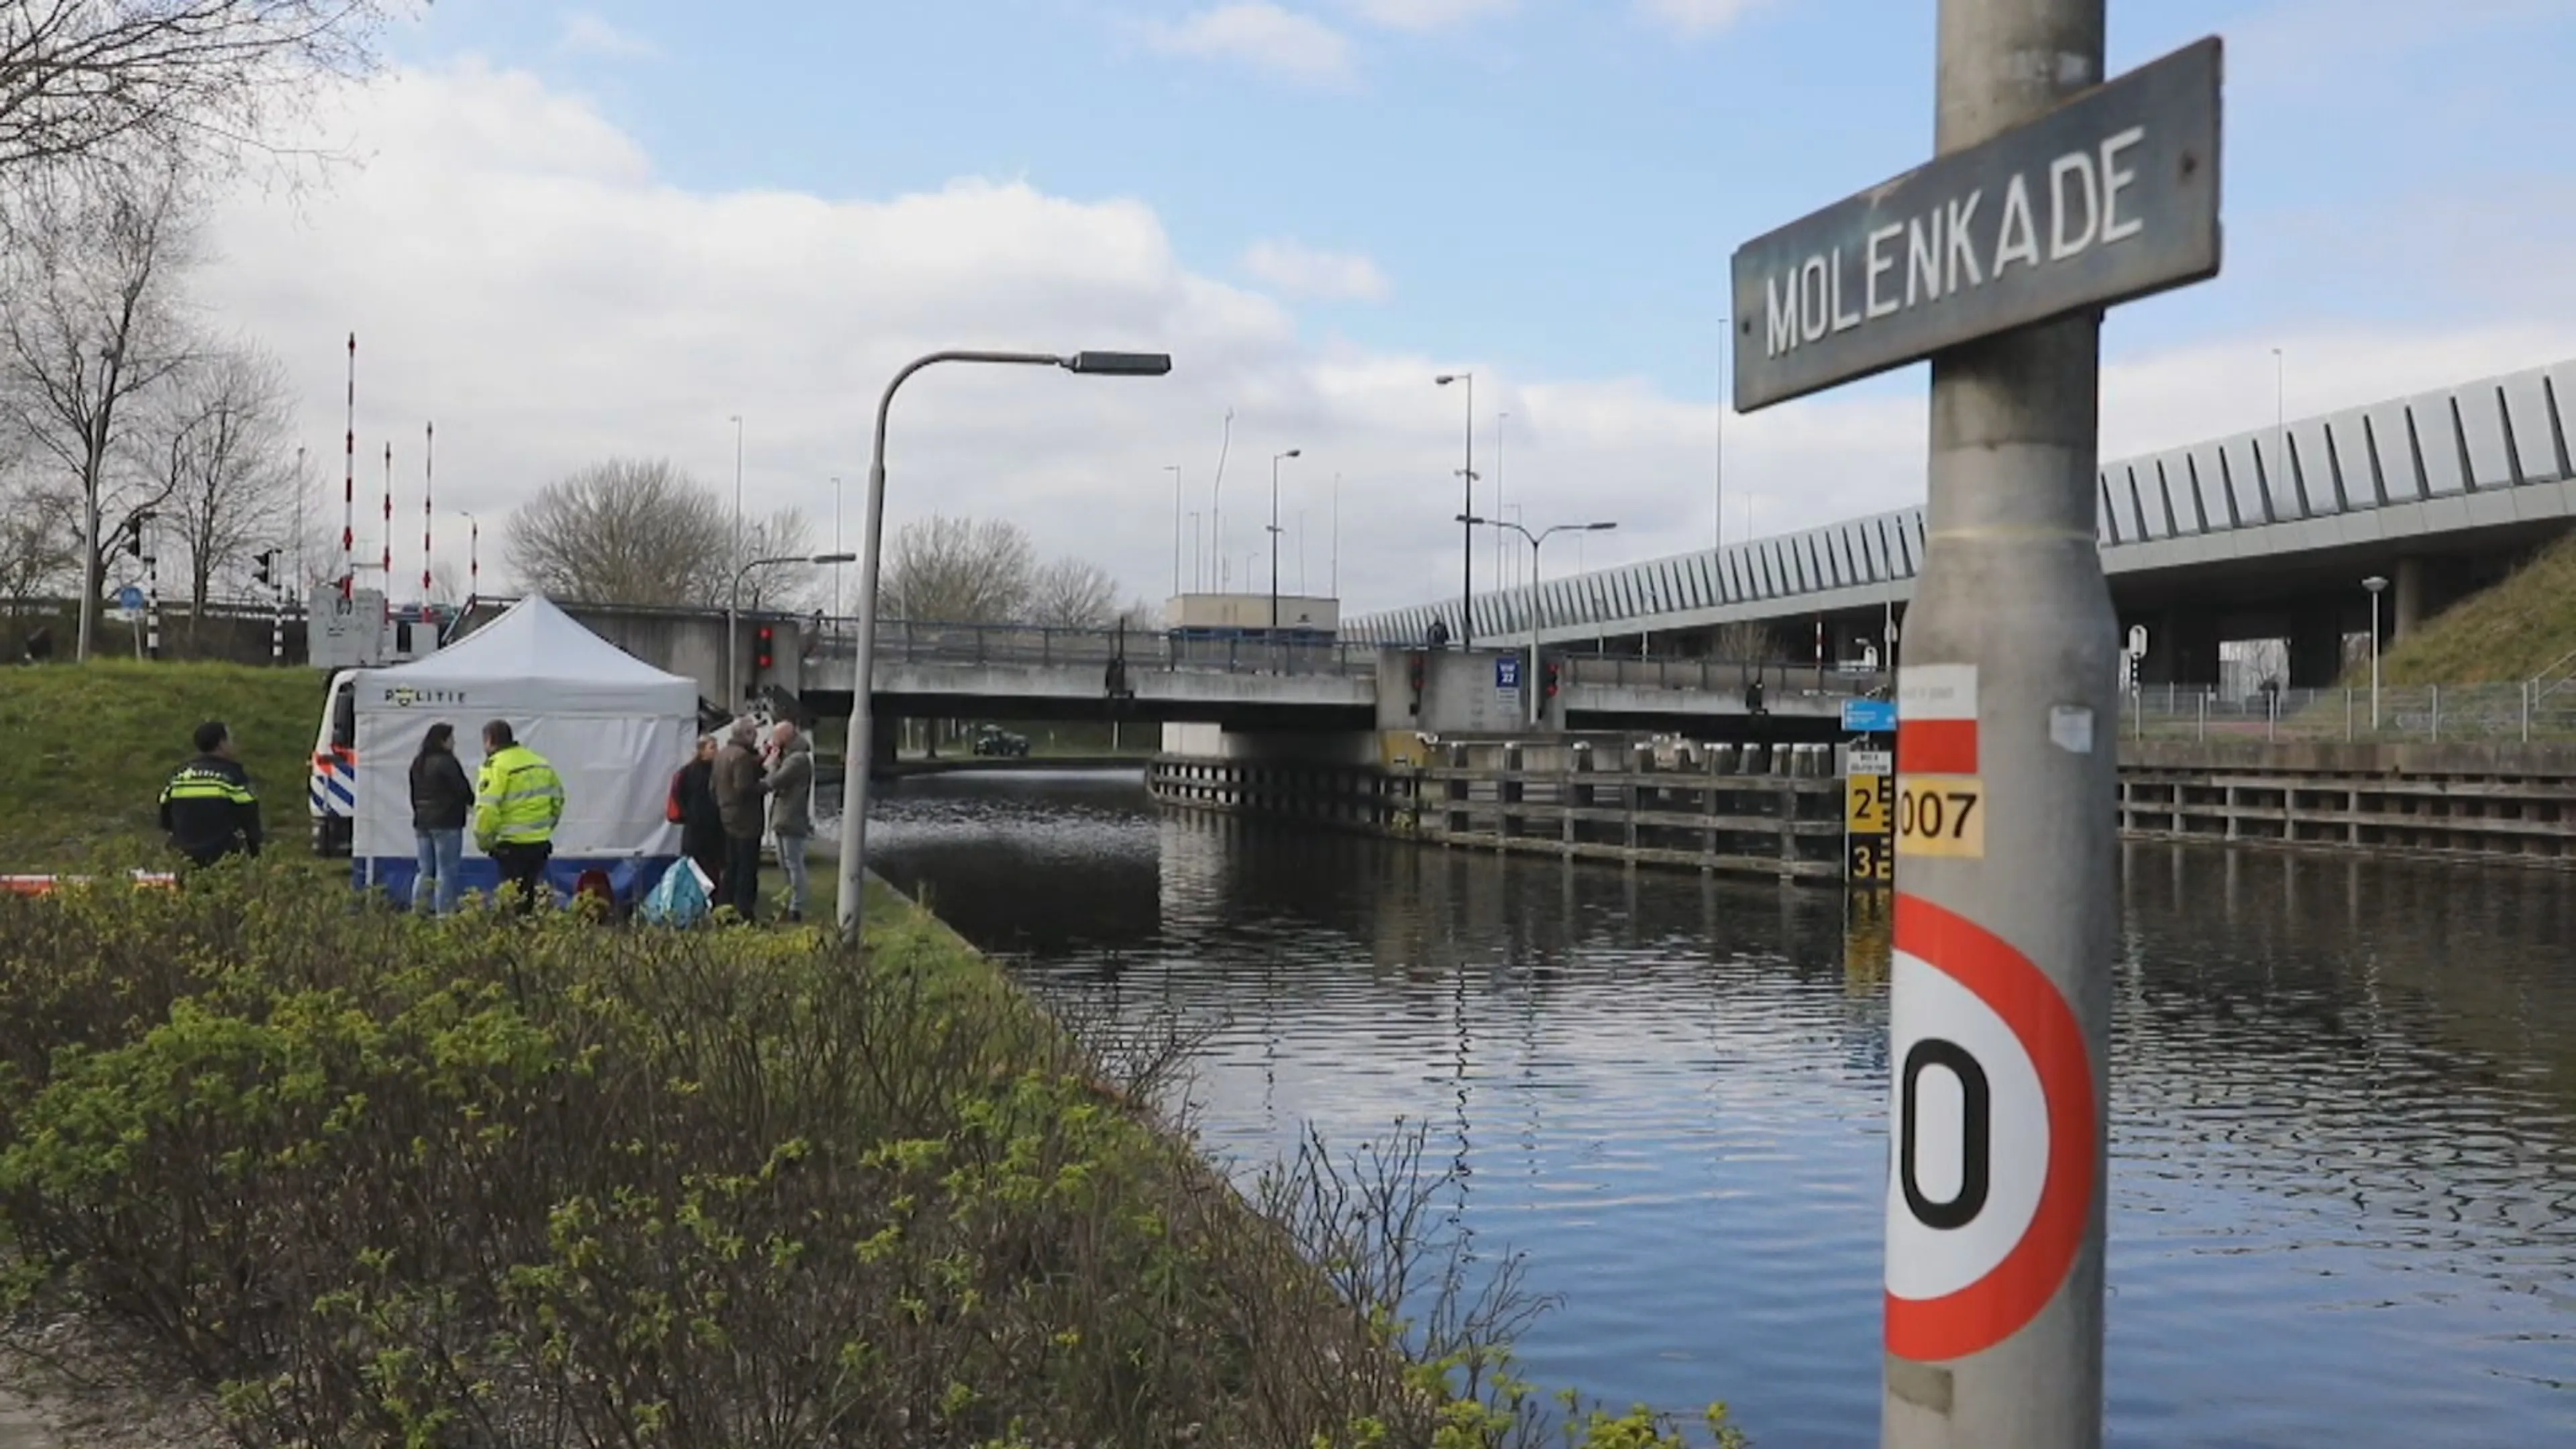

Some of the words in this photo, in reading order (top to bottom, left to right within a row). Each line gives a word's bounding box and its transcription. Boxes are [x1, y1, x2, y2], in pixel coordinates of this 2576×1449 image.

[1765, 126, 2145, 359] MOLENKADE
[1854, 788, 1872, 819] 2
[1900, 790, 1978, 839] 007
[1853, 845, 1872, 877] 3
[1901, 1037, 1990, 1231] 0
